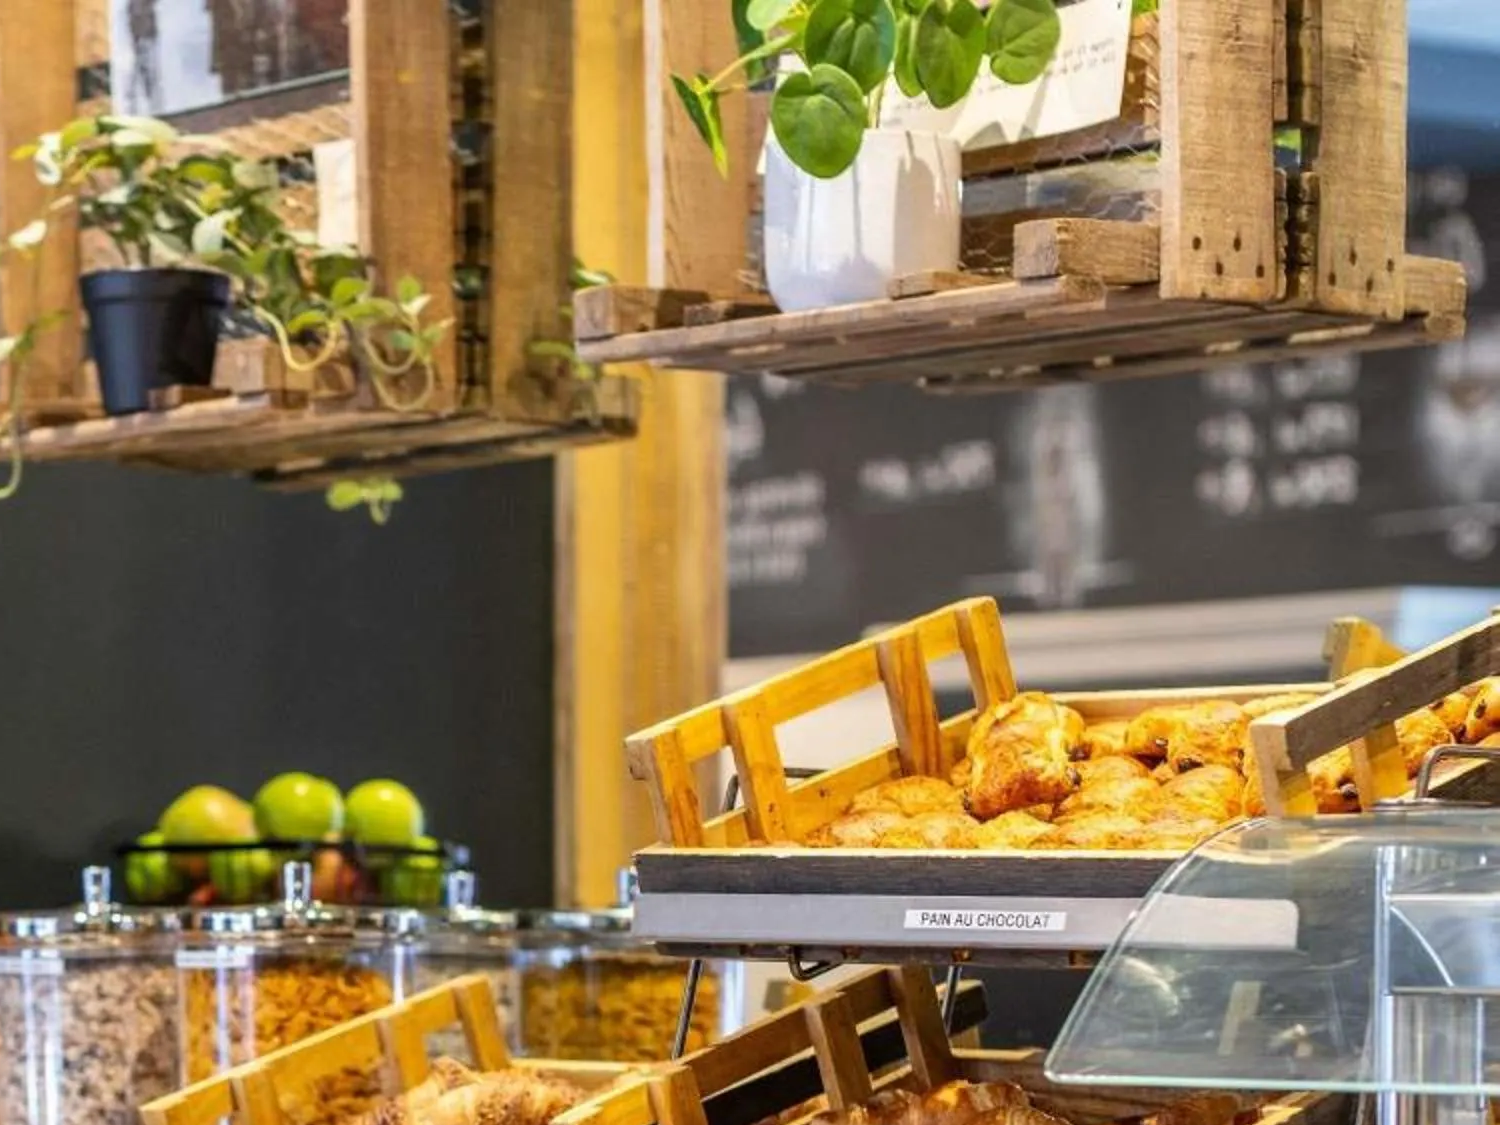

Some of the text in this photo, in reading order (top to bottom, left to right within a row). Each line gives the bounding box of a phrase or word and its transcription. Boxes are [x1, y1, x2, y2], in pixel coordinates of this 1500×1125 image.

[921, 911, 1051, 929] PAIN AU CHOCOLAT
